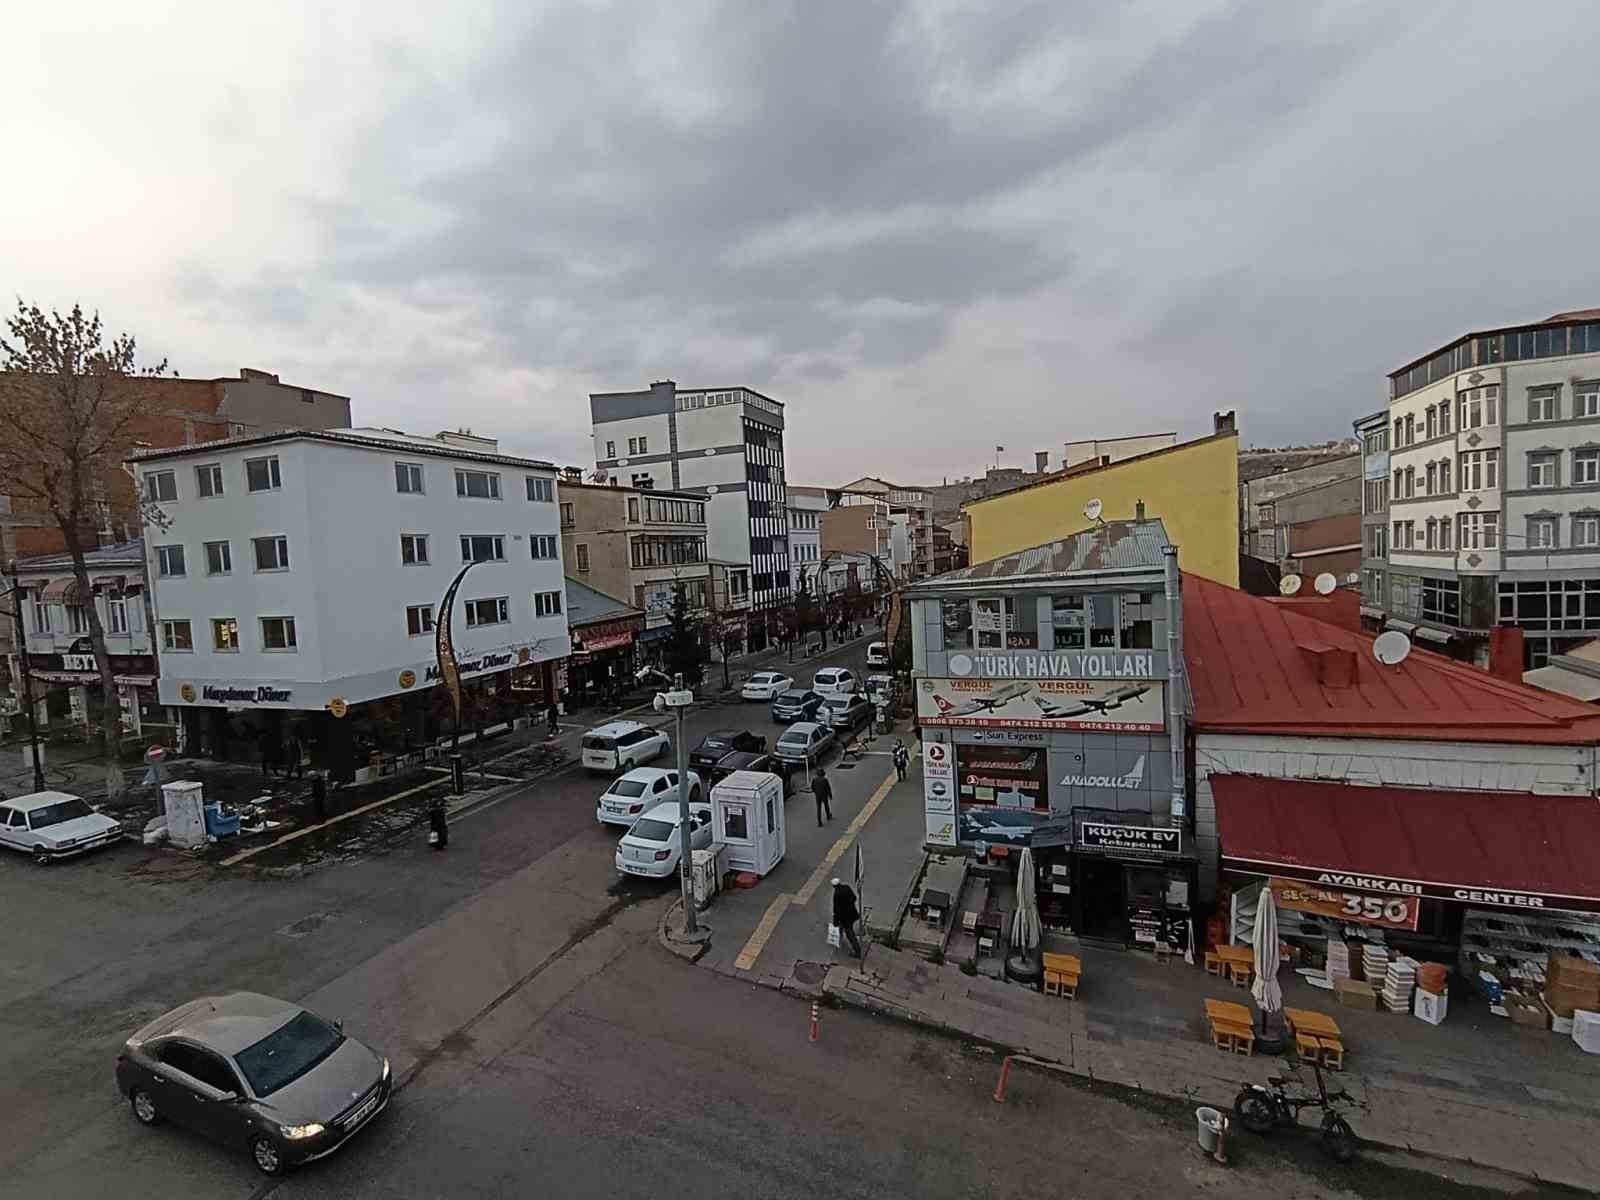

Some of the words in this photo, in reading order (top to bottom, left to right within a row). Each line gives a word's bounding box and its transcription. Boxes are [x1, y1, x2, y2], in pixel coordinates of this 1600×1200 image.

[1026, 655, 1071, 676] HAVA
[1076, 655, 1152, 677] YOLLARI
[986, 730, 1004, 740] Sun
[1007, 731, 1043, 743] Express
[1152, 831, 1176, 842] EV
[1318, 873, 1423, 895] AYAKKABI
[1453, 889, 1545, 907] CENTER
[1341, 893, 1408, 923] 350
